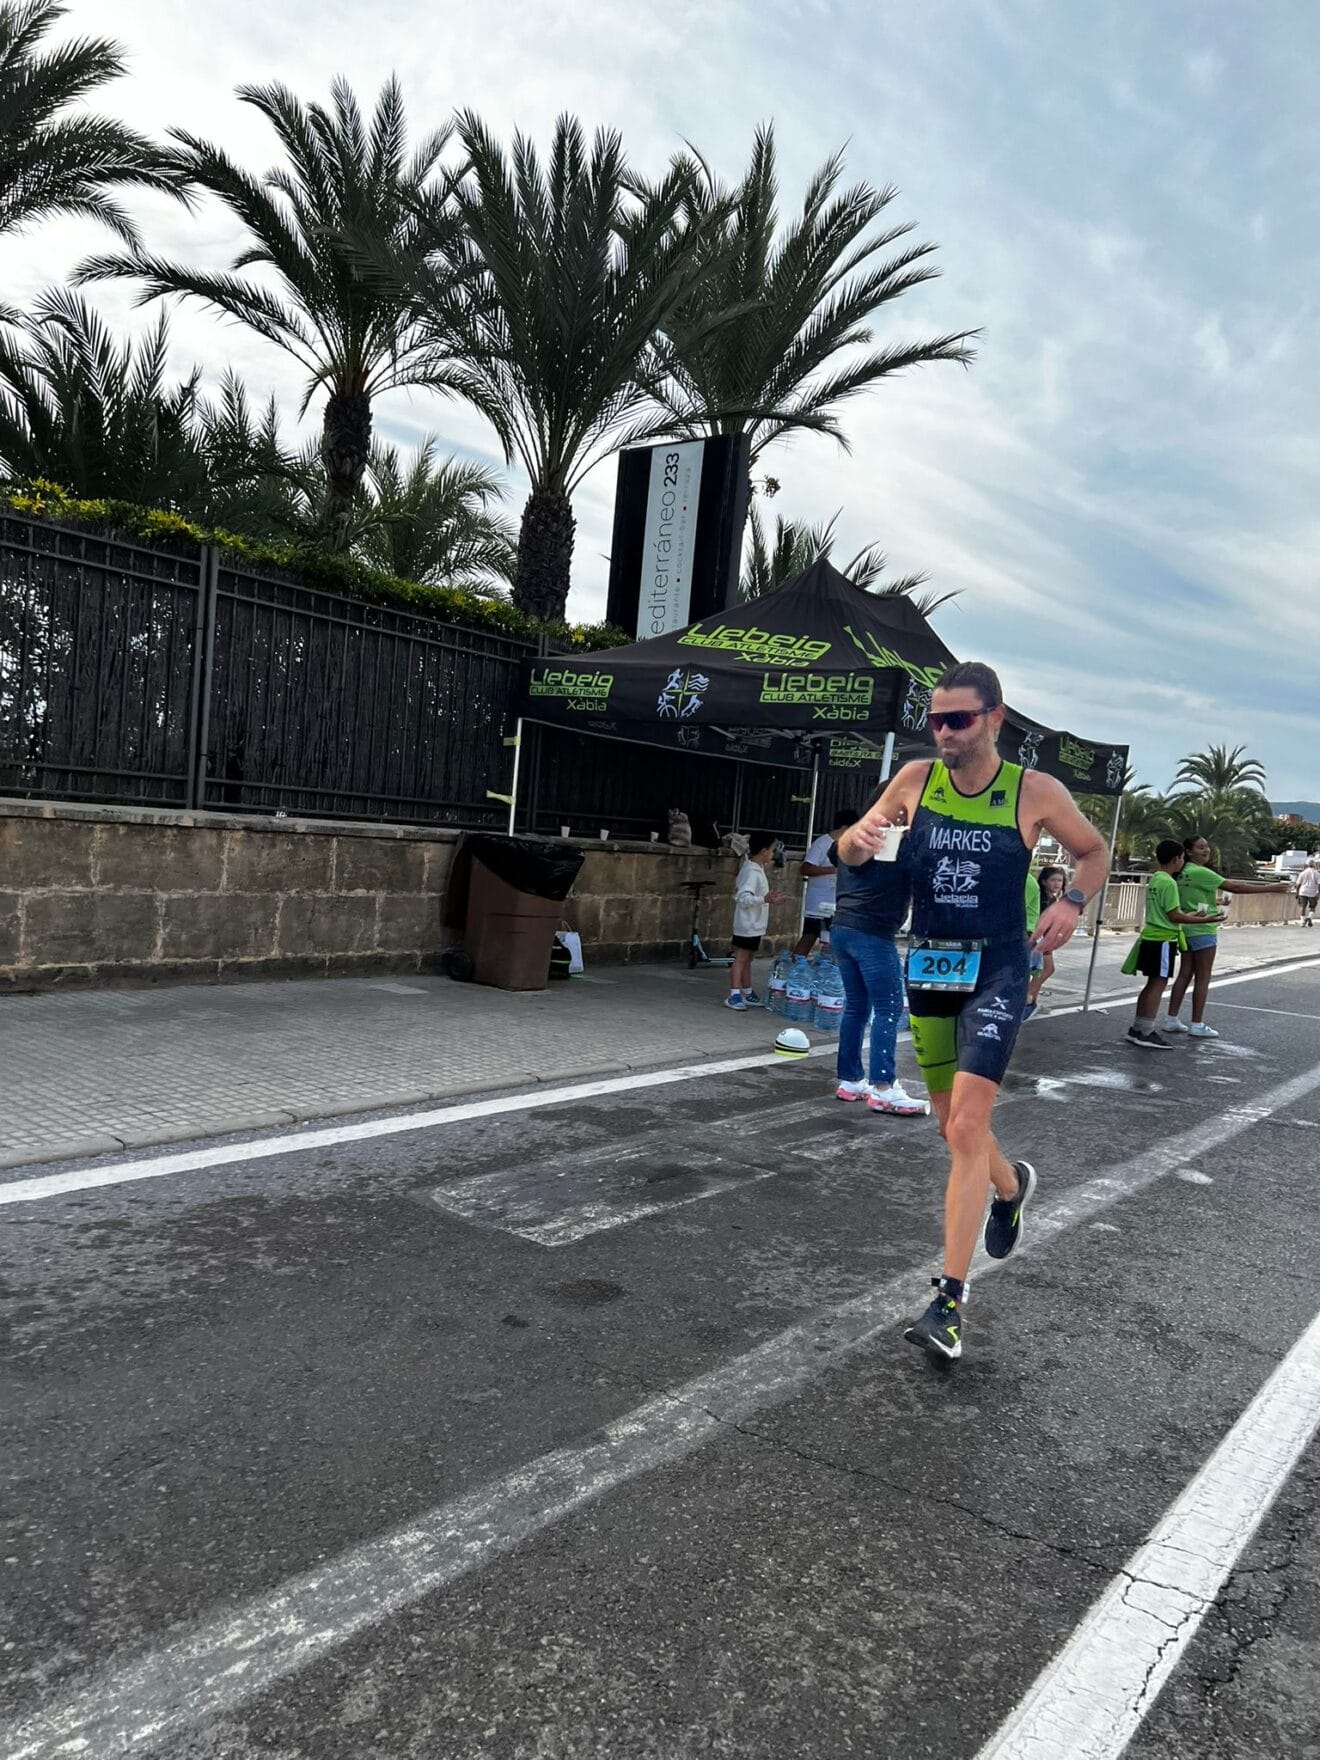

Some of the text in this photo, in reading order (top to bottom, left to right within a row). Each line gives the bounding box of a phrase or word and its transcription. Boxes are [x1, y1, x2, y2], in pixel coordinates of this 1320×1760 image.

[648, 452, 680, 635] editerráneo 233
[681, 636, 815, 659] CLUB ATLETISME
[687, 623, 832, 656] Llebeig
[530, 668, 614, 691] Llebeig
[763, 672, 875, 696] Llebeig
[530, 686, 607, 697] CLUB ATLETISME
[761, 692, 870, 704] CLUB ATLETISME
[566, 697, 608, 712] Xàbia
[812, 704, 870, 720] Xàbia
[929, 826, 992, 853] MARKES
[921, 956, 967, 976] 204
